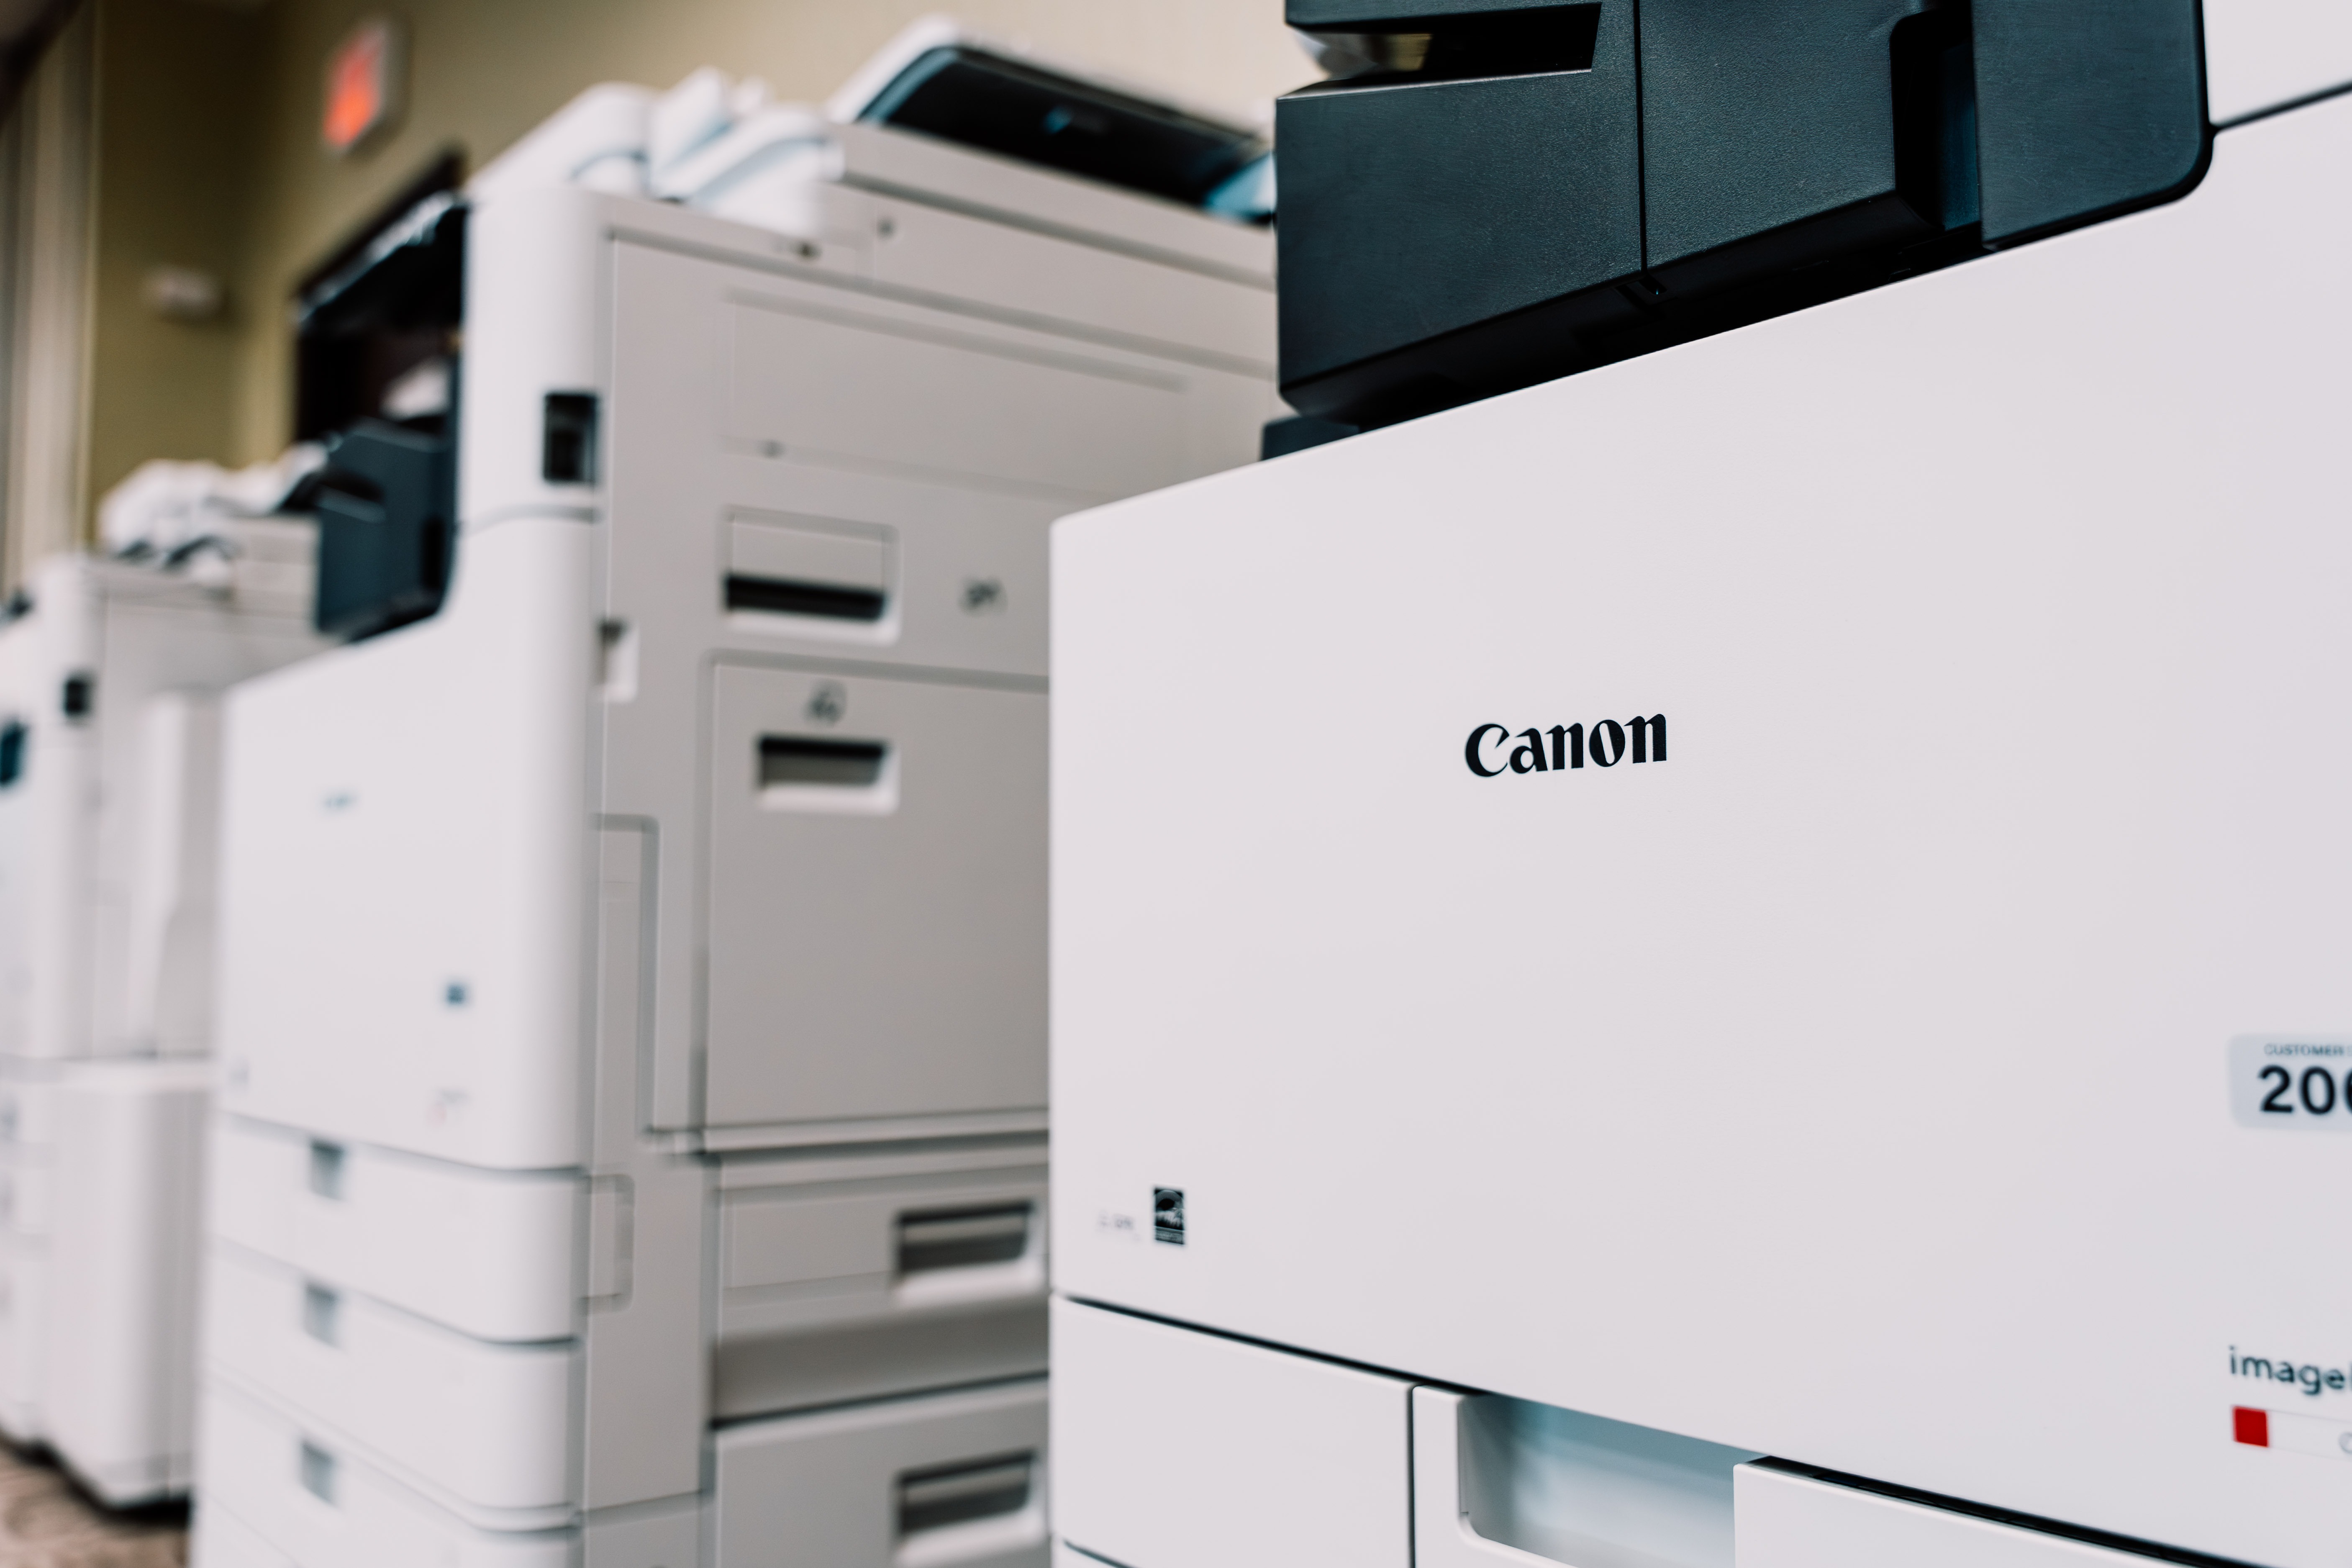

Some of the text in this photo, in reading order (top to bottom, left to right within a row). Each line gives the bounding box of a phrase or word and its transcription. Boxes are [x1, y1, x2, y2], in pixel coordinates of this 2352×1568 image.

[1465, 714, 1666, 777] Canon
[2258, 1064, 2352, 1116] 20
[2229, 1345, 2352, 1396] image
